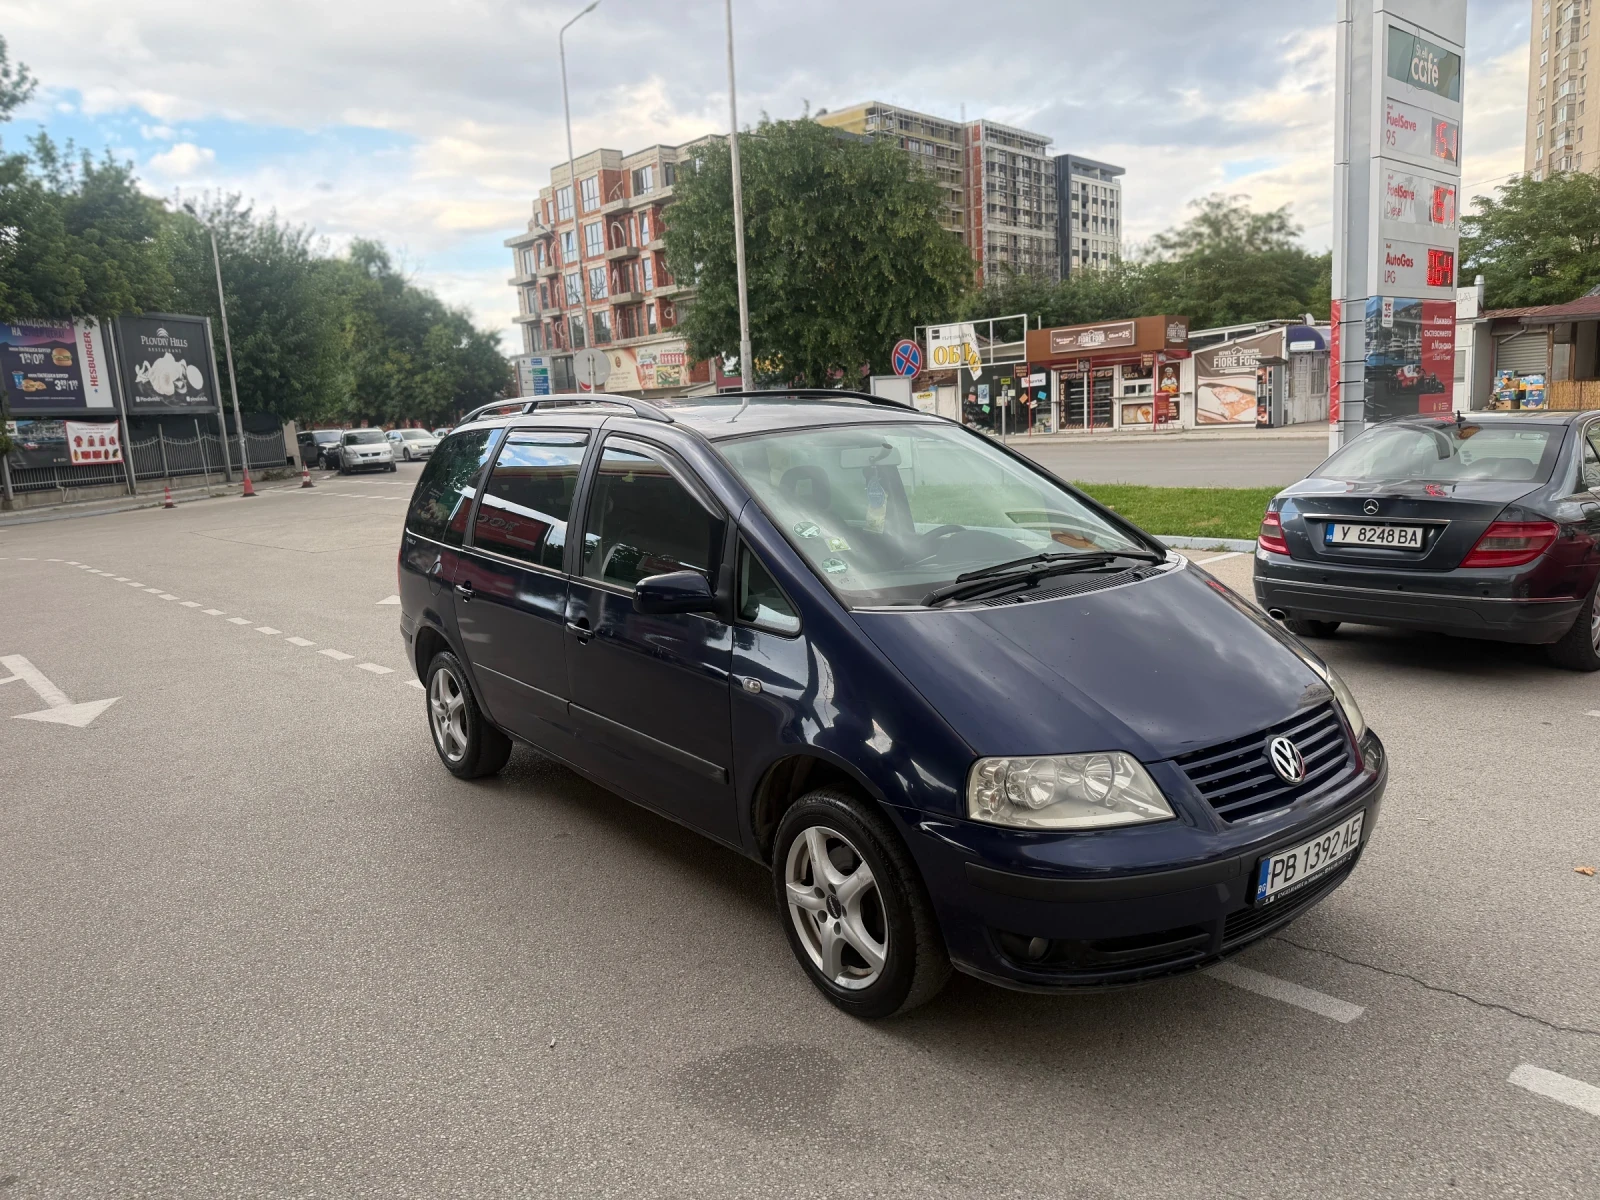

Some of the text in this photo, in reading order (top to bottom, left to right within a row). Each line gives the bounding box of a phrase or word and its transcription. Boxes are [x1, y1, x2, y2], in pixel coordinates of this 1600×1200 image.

[1411, 53, 1438, 87] café
[1386, 111, 1416, 131] FuelSave
[1386, 129, 1396, 145] 95
[1387, 182, 1414, 200] FuelSave
[1386, 252, 1414, 268] AutoGas
[1384, 270, 1396, 283] LPG
[11, 327, 22, 336] НА
[83, 331, 99, 387] HESBURGER
[1213, 356, 1237, 367] FIORE
[1358, 527, 1395, 543] 8248
[1398, 530, 1418, 545] BA
[1271, 854, 1297, 888] PB
[1304, 831, 1340, 873] 1392
[1341, 817, 1360, 853] AE
[1257, 883, 1266, 894] BG
